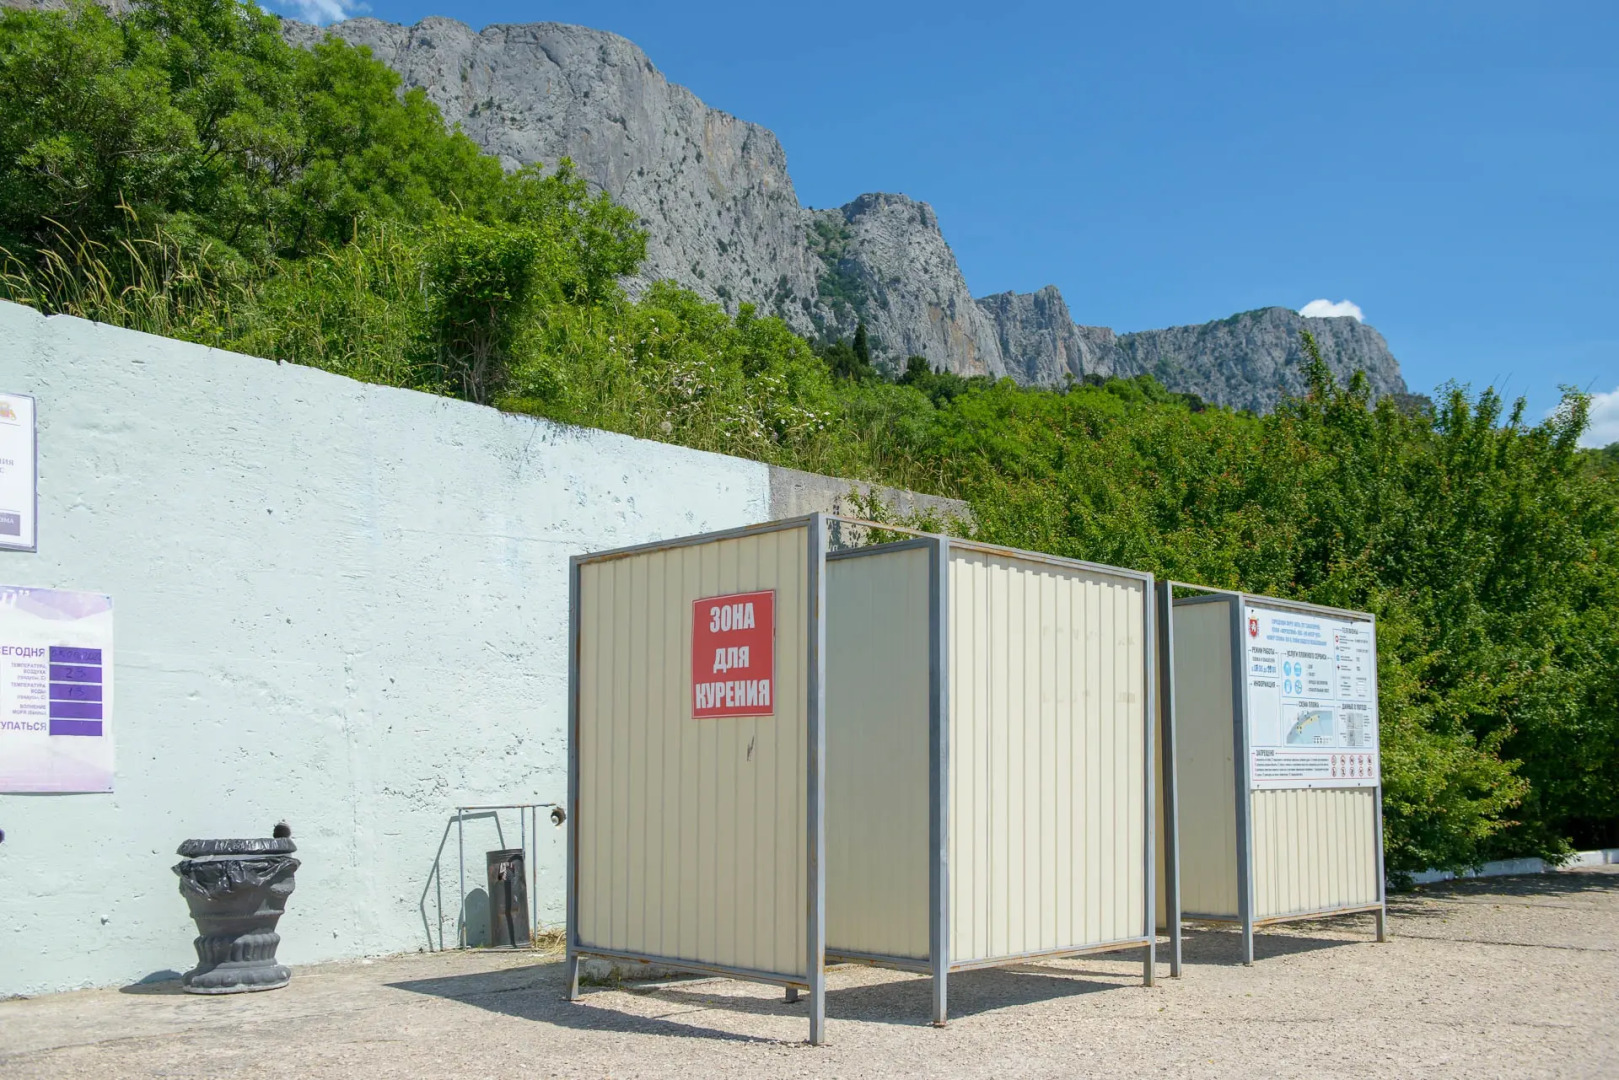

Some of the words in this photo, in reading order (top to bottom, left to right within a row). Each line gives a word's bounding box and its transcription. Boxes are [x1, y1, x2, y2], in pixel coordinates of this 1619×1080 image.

[709, 602, 755, 633] ЗОНА
[0, 645, 45, 658] ЕГОДНЯ
[713, 646, 750, 674] ДЛЯ
[695, 679, 770, 709] КУРЕНИЯ
[0, 721, 47, 731] УПАТЬСЯ
